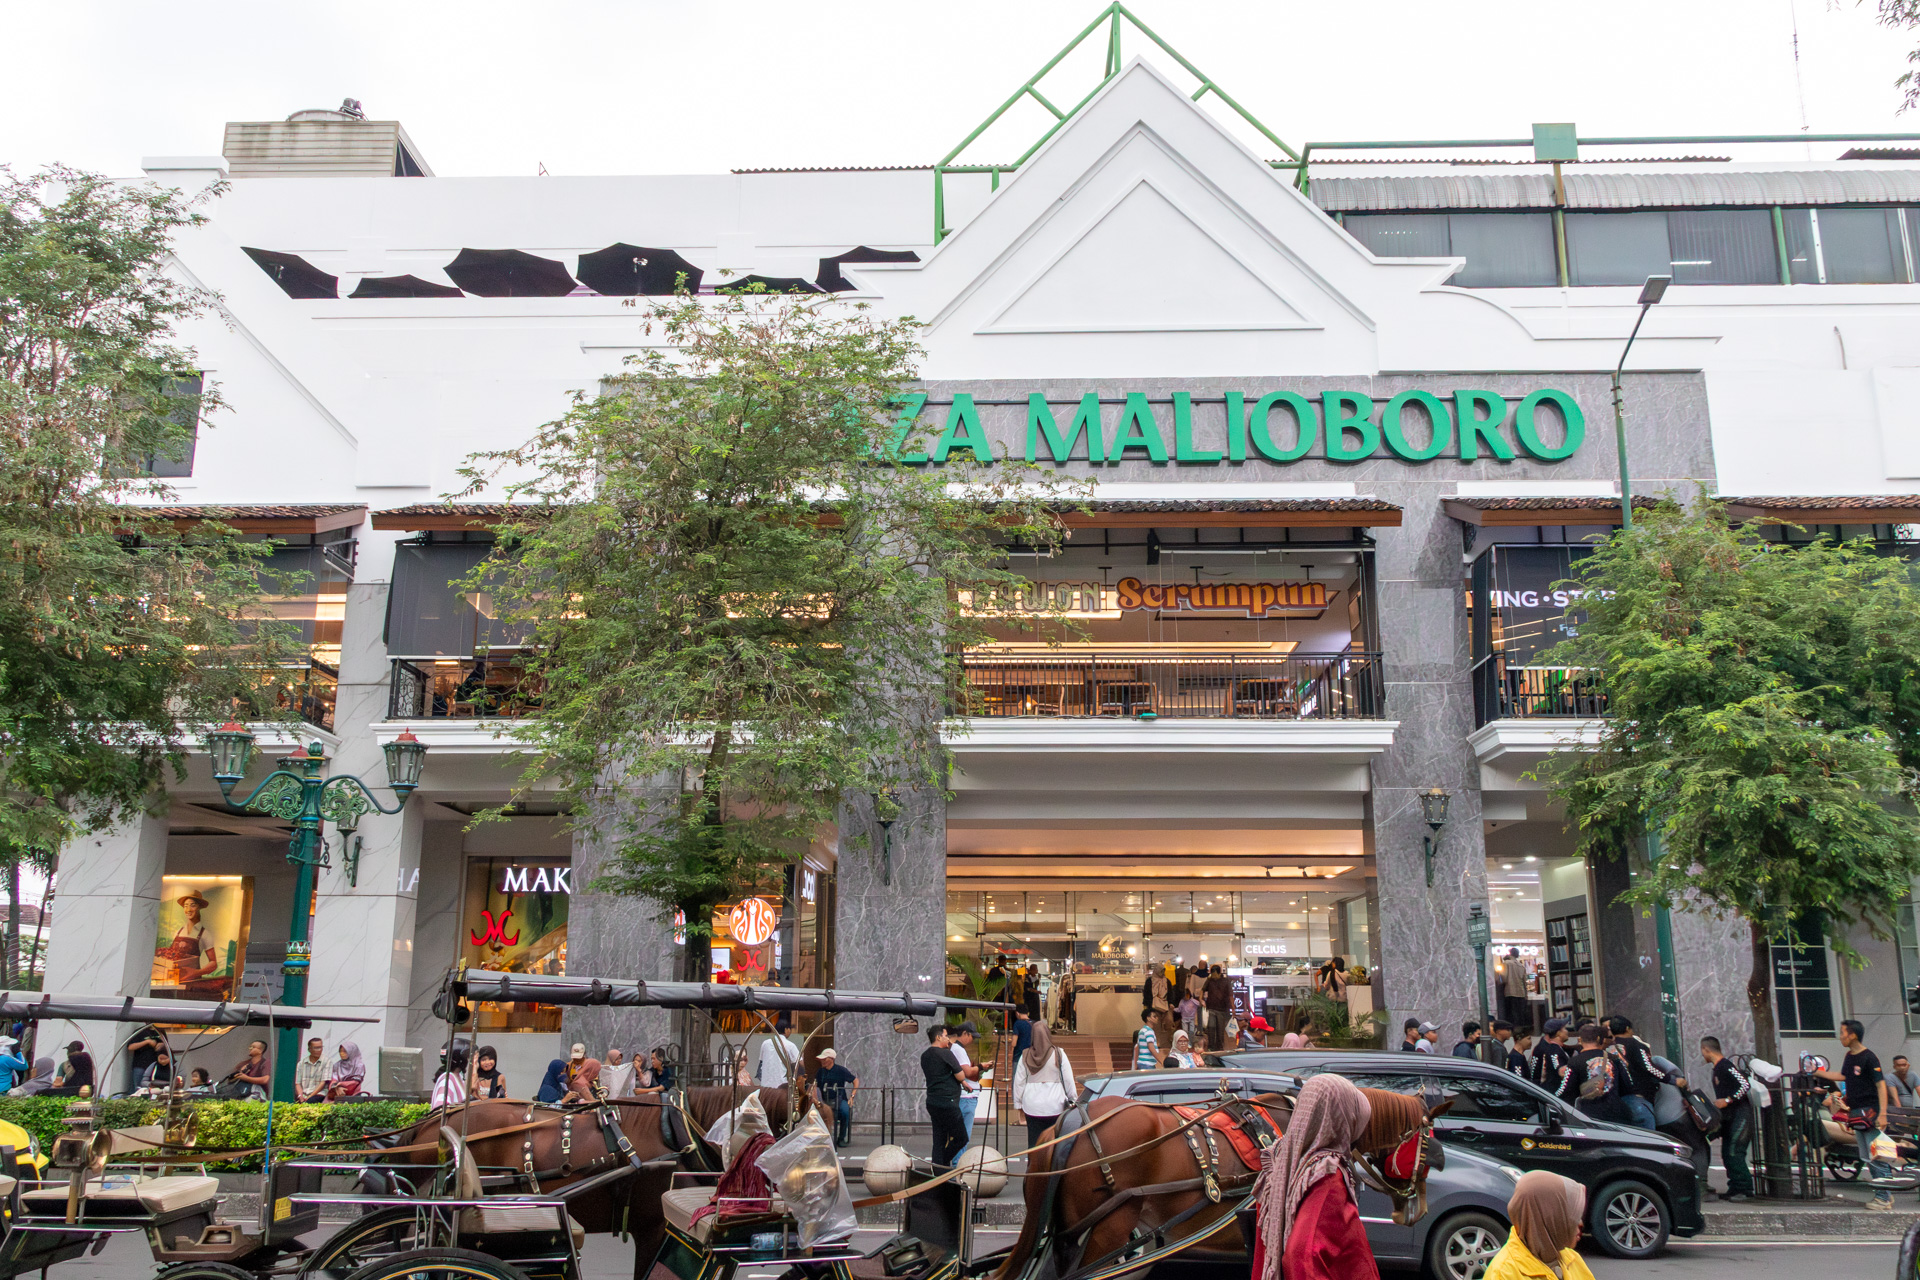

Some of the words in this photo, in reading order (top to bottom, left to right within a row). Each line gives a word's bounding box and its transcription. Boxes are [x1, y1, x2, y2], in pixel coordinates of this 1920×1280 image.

[1025, 389, 1585, 464] MALIOBORO
[1116, 577, 1329, 618] Serumpun
[1245, 944, 1287, 954] CELCIUS
[1538, 1141, 1572, 1151] Goldenbird
